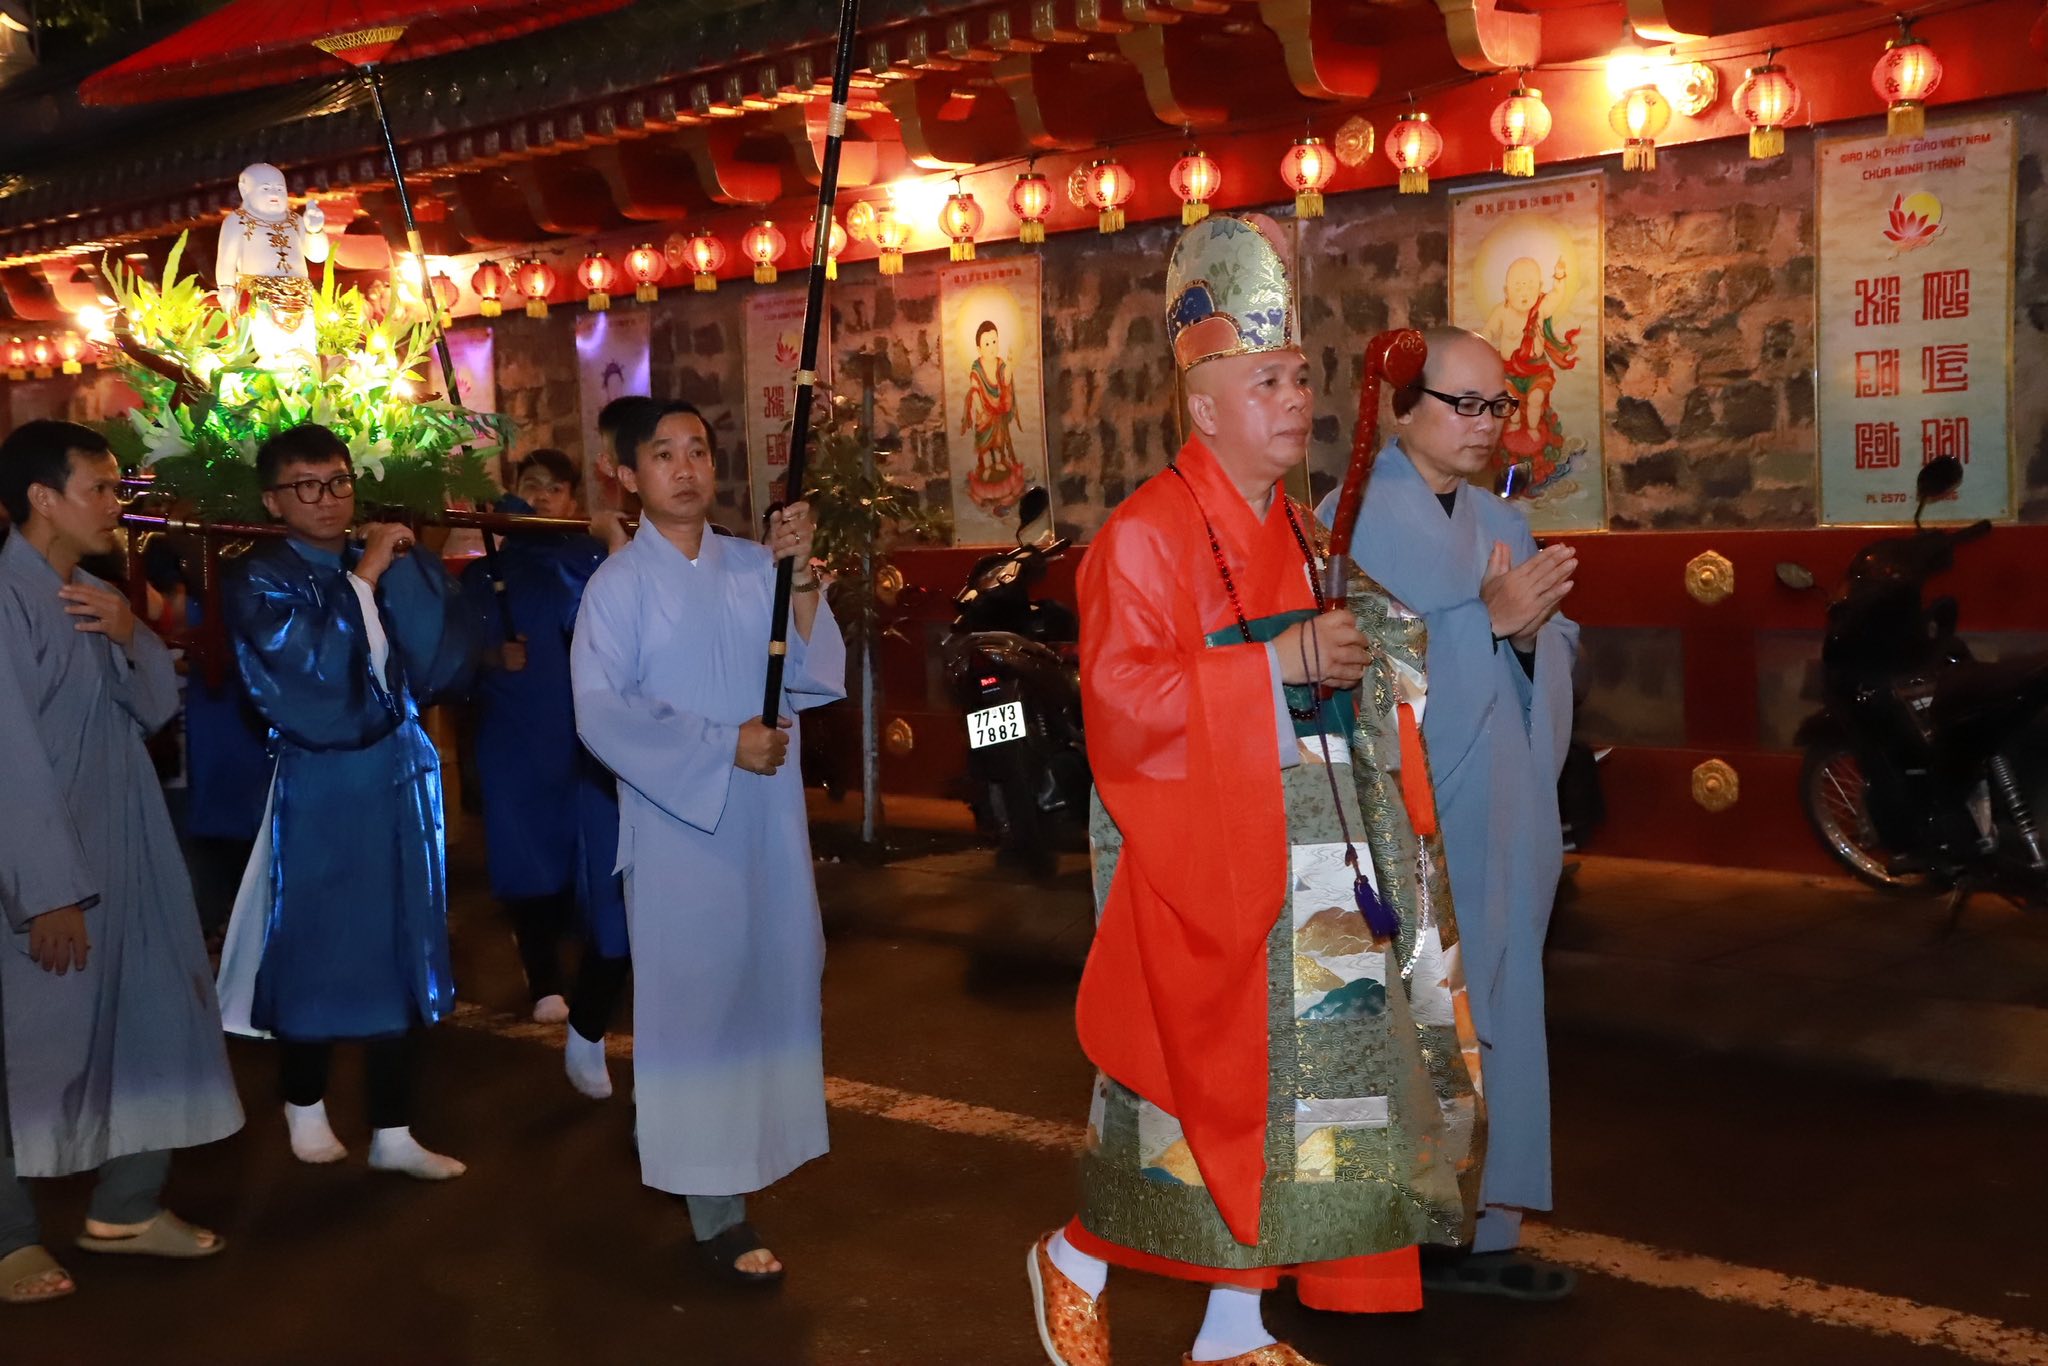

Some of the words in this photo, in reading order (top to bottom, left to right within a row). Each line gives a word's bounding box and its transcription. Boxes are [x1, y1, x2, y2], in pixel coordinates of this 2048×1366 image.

[1966, 133, 1992, 146] NAM
[1895, 162, 1924, 176] MINH
[1866, 494, 1878, 504] PL
[1881, 493, 1906, 503] 2570
[974, 704, 1016, 729] 77-Y3
[976, 722, 1019, 745] 7882
